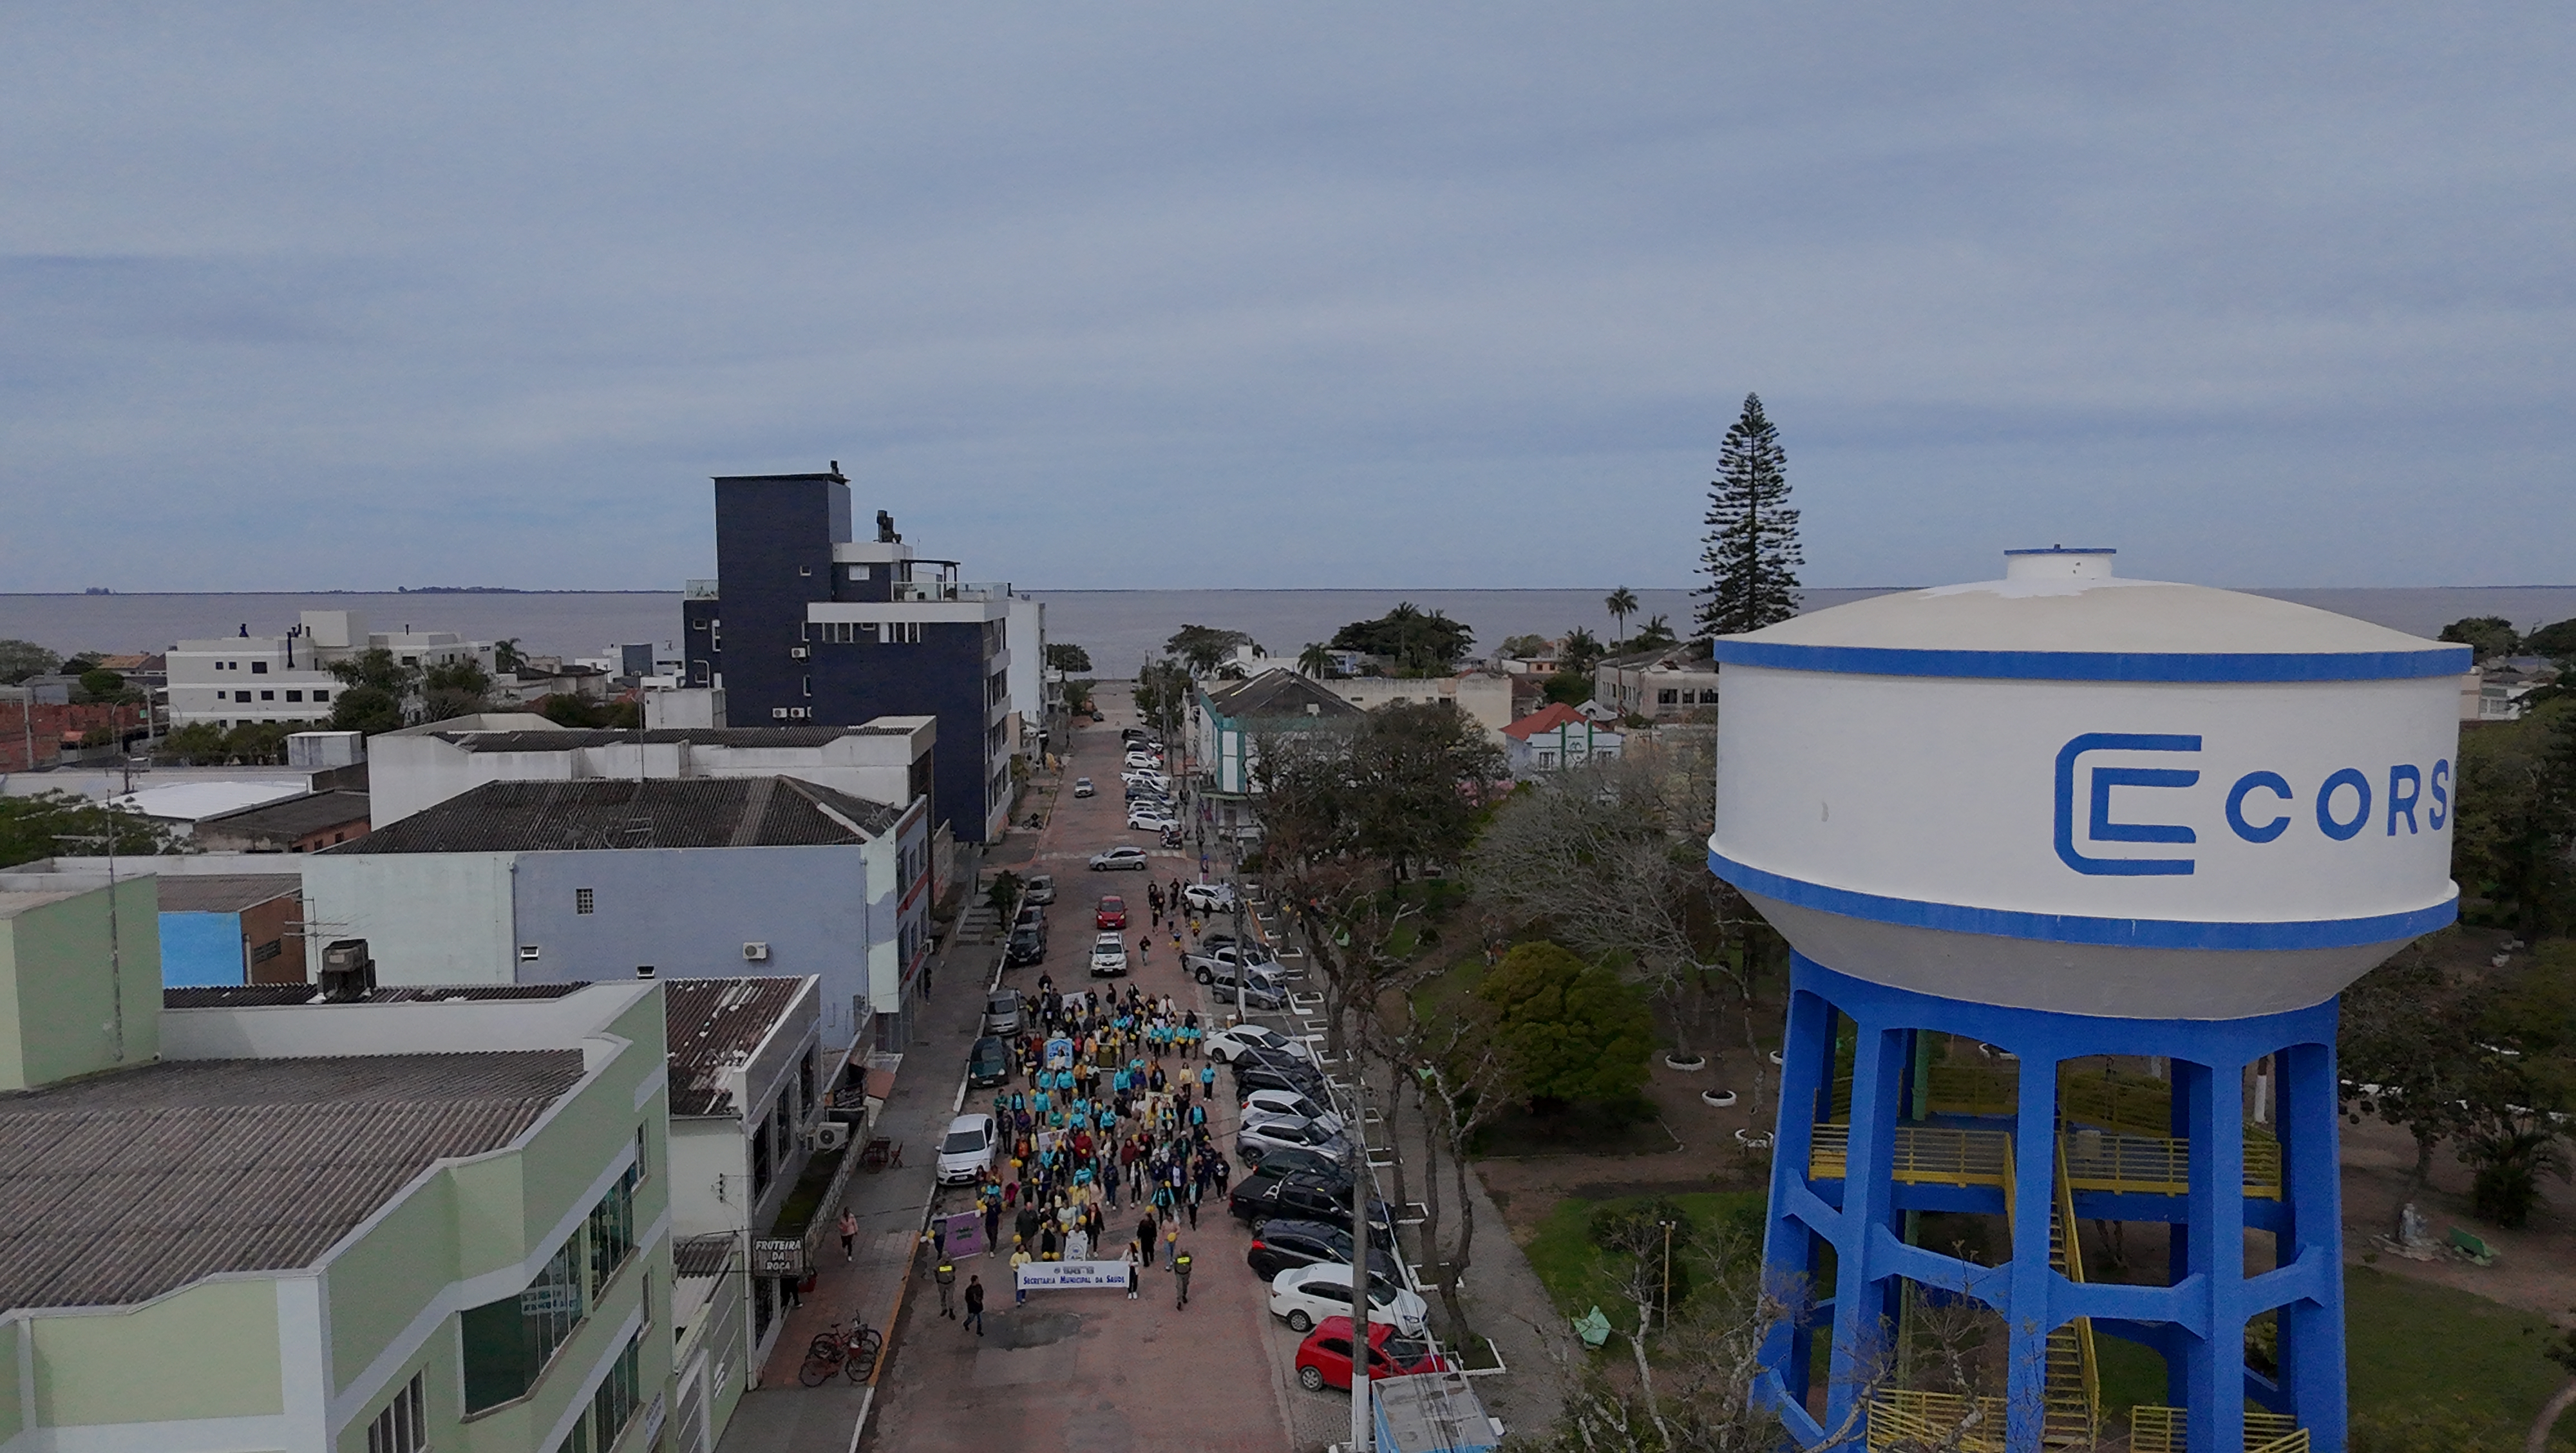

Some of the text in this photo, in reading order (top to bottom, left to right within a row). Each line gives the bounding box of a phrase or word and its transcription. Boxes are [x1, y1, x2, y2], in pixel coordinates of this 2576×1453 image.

[2225, 758, 2456, 844] CORS
[756, 1240, 801, 1250] FRUTEIRA
[772, 1252, 784, 1260] DA
[767, 1262, 790, 1273] ROÇA
